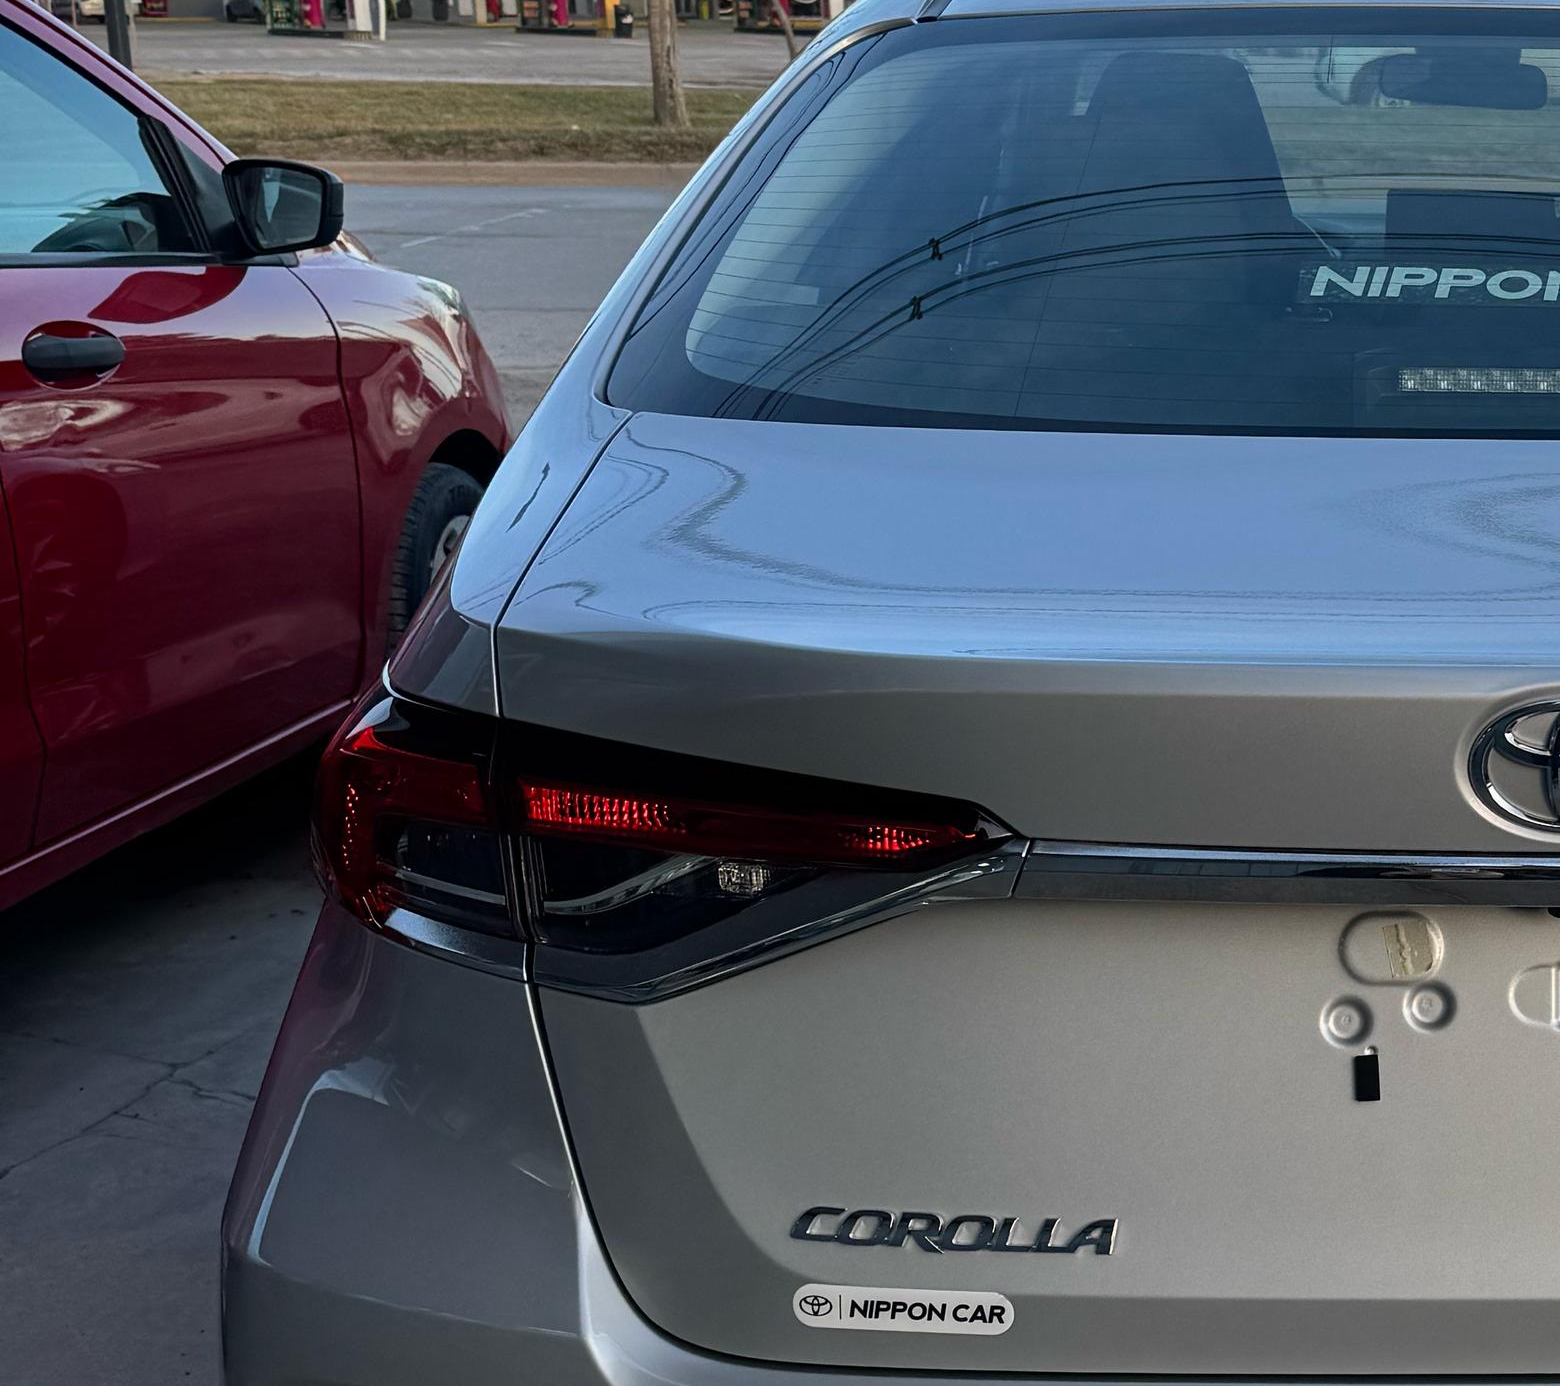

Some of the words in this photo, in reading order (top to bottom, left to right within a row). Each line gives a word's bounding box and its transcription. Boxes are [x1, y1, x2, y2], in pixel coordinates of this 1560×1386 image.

[790, 1206, 1119, 1256] COROLLA
[849, 1299, 947, 1322] NIPPON
[952, 1304, 1006, 1324] CAR
